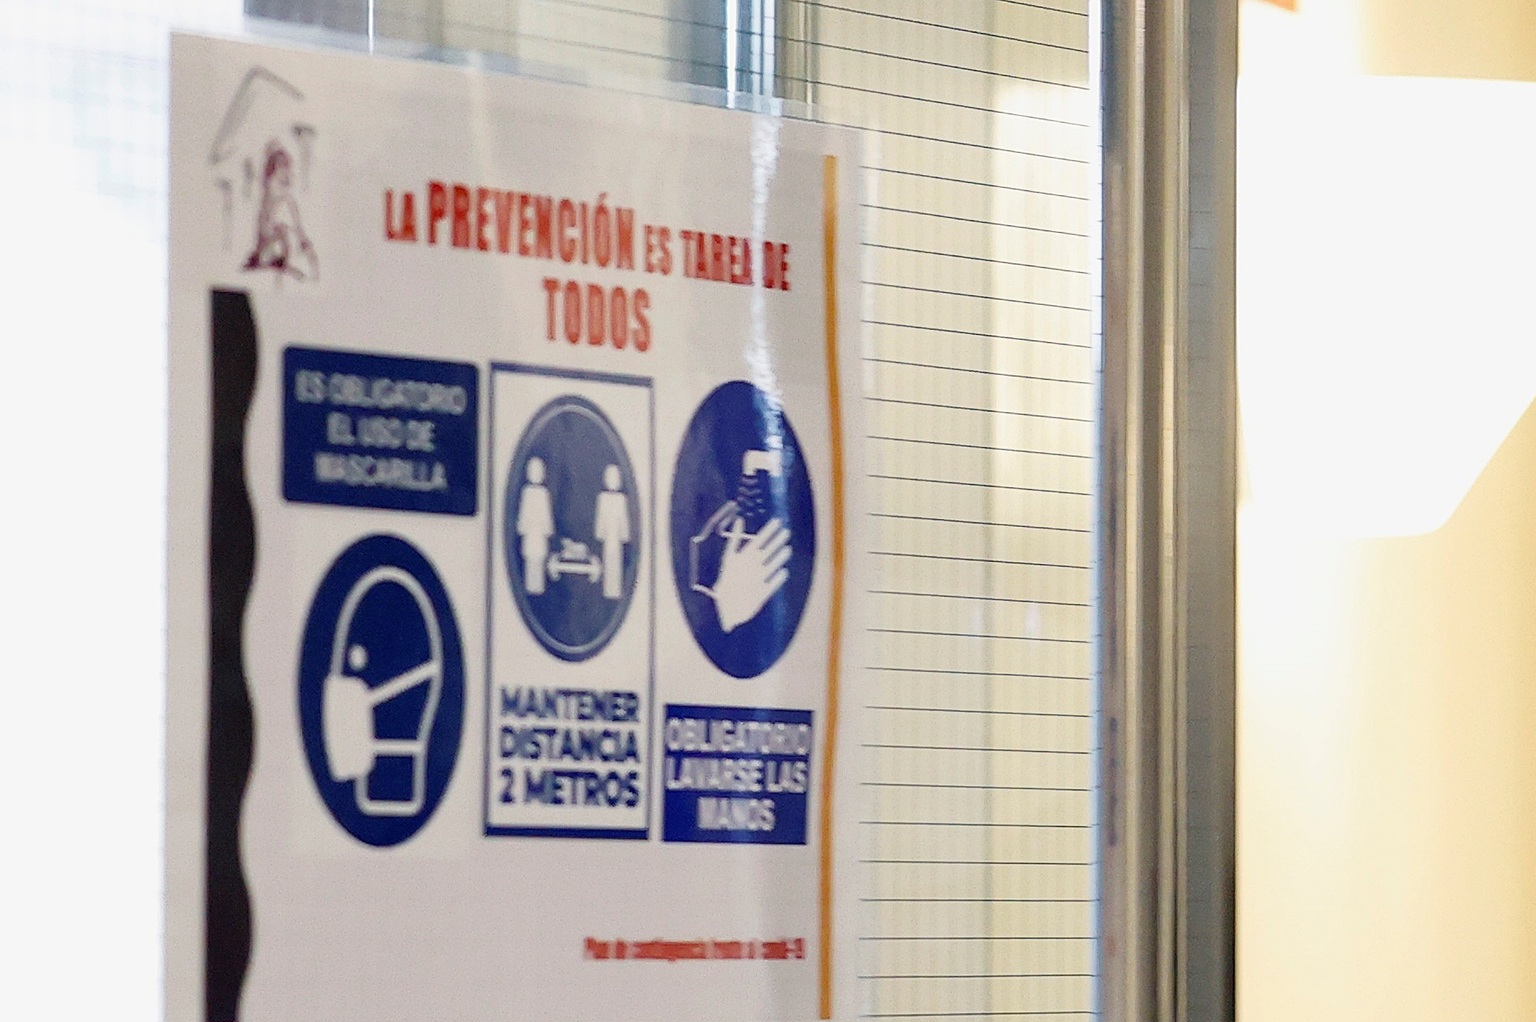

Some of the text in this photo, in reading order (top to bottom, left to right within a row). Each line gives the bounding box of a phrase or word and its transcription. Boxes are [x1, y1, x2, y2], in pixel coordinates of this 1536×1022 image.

[384, 189, 417, 243] LA
[426, 179, 635, 272] PREVENCIÓN
[642, 223, 673, 276] ES
[542, 276, 652, 353] TODOS
[500, 685, 641, 723] MANTENER
[500, 724, 641, 764] DISTANCIA
[666, 716, 811, 756] OBLIGATORIO
[500, 767, 641, 808] 2 METROS
[766, 760, 807, 795] LAS
